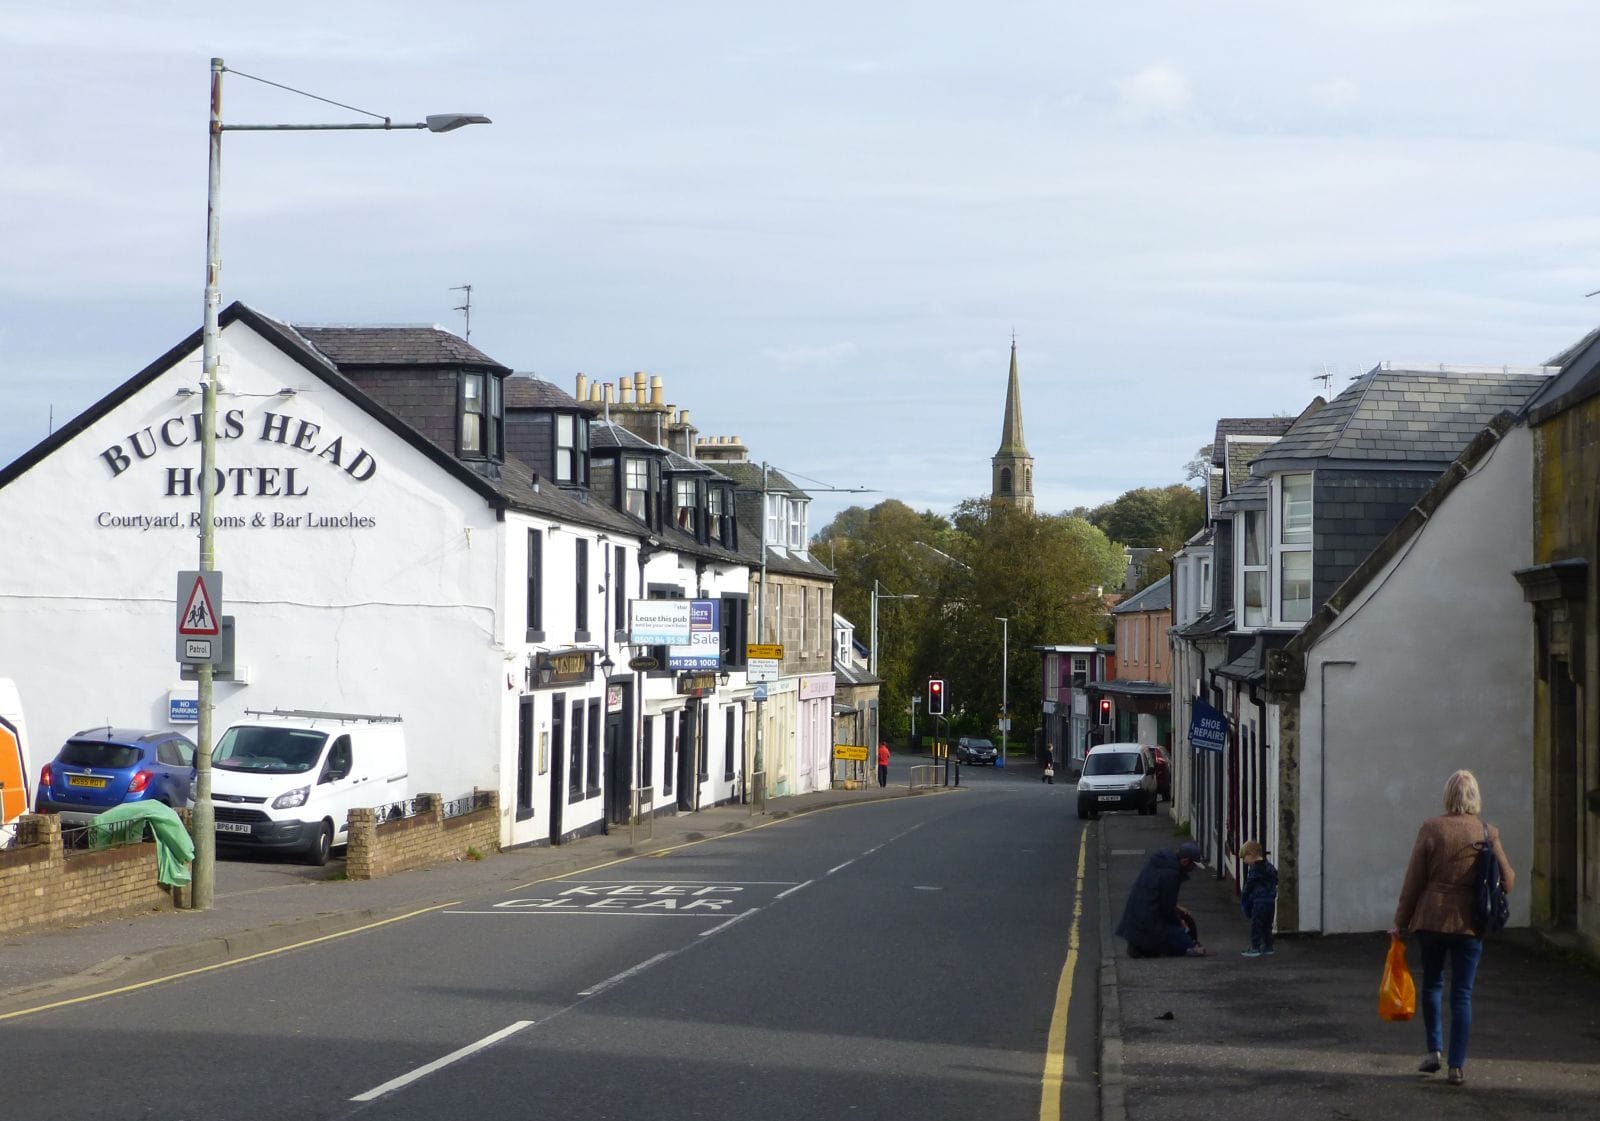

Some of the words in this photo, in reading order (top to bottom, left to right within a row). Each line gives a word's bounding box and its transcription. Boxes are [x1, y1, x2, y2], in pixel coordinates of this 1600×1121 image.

[100, 409, 245, 478] BUCKS
[259, 411, 377, 482] HEAD
[164, 467, 309, 496] HOTEL
[97, 511, 185, 532] Courtyard,
[190, 511, 246, 528] Roms
[252, 511, 266, 528] &
[273, 511, 303, 528] Bar
[307, 511, 377, 528] Lunches
[635, 615, 657, 623] Lease
[657, 615, 672, 623] this
[672, 616, 688, 624] pub
[692, 633, 720, 645] Sale
[189, 645, 207, 654] Patrol
[683, 659, 697, 667] 226
[700, 659, 717, 667] 1000
[1201, 718, 1221, 730] SHOE
[1194, 727, 1224, 741] REPAIRS
[558, 885, 744, 896] KEEP
[492, 897, 734, 910] CLEAR
